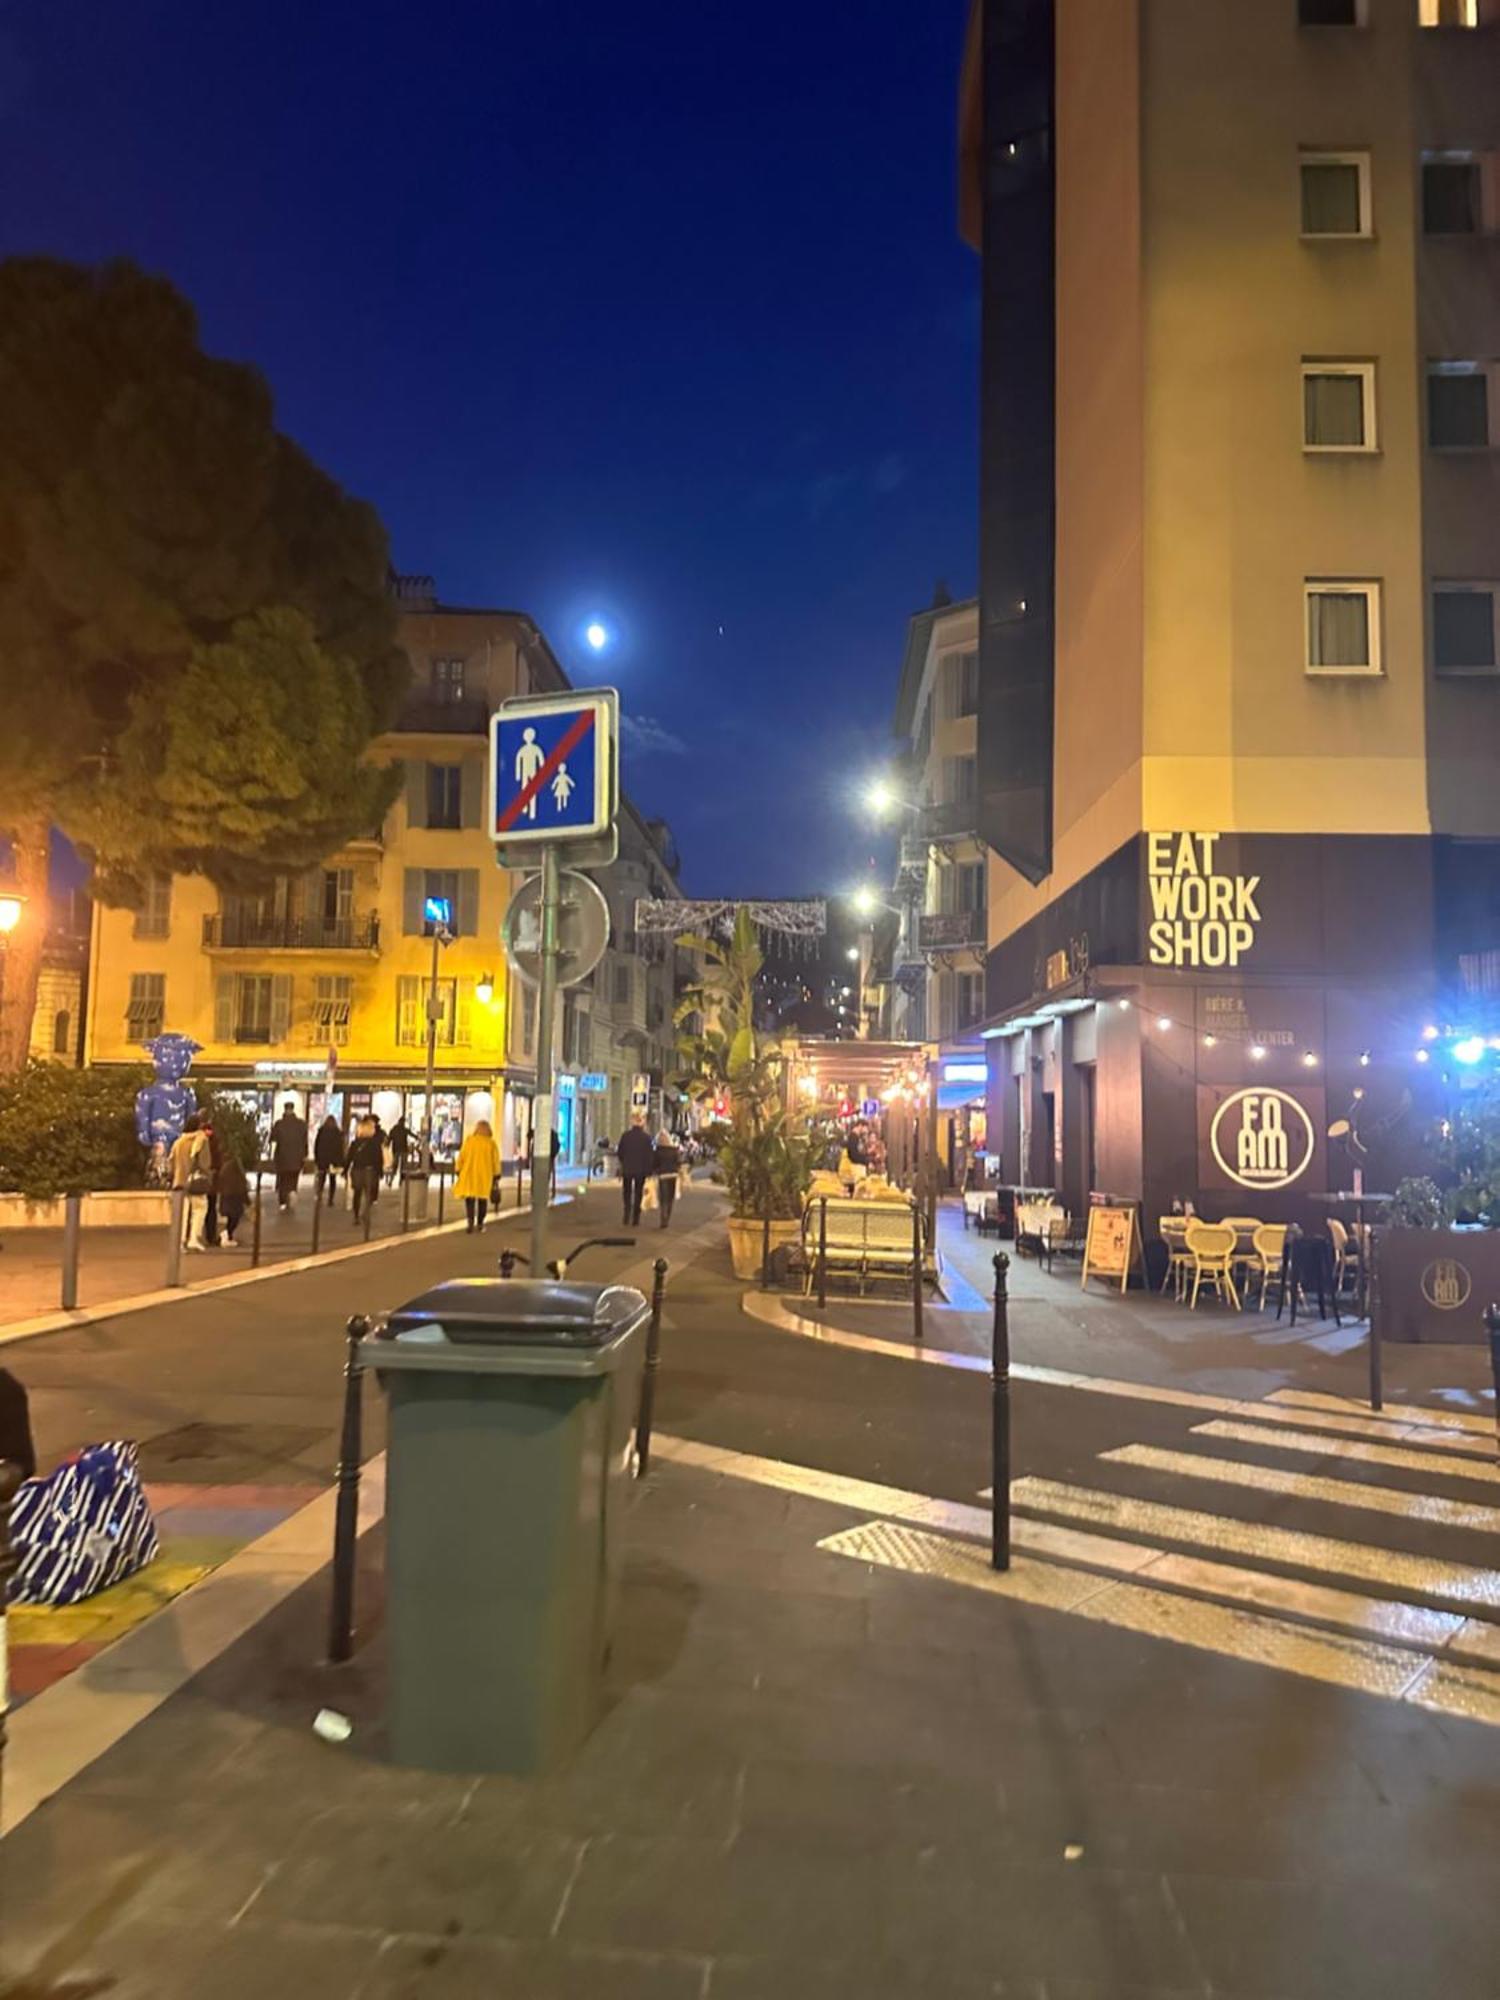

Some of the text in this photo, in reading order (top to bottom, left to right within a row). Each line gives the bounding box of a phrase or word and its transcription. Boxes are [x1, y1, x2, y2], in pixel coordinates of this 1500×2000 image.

[1148, 832, 1219, 875] EAT
[1149, 876, 1261, 920] WORK
[1149, 921, 1254, 966] SHOP
